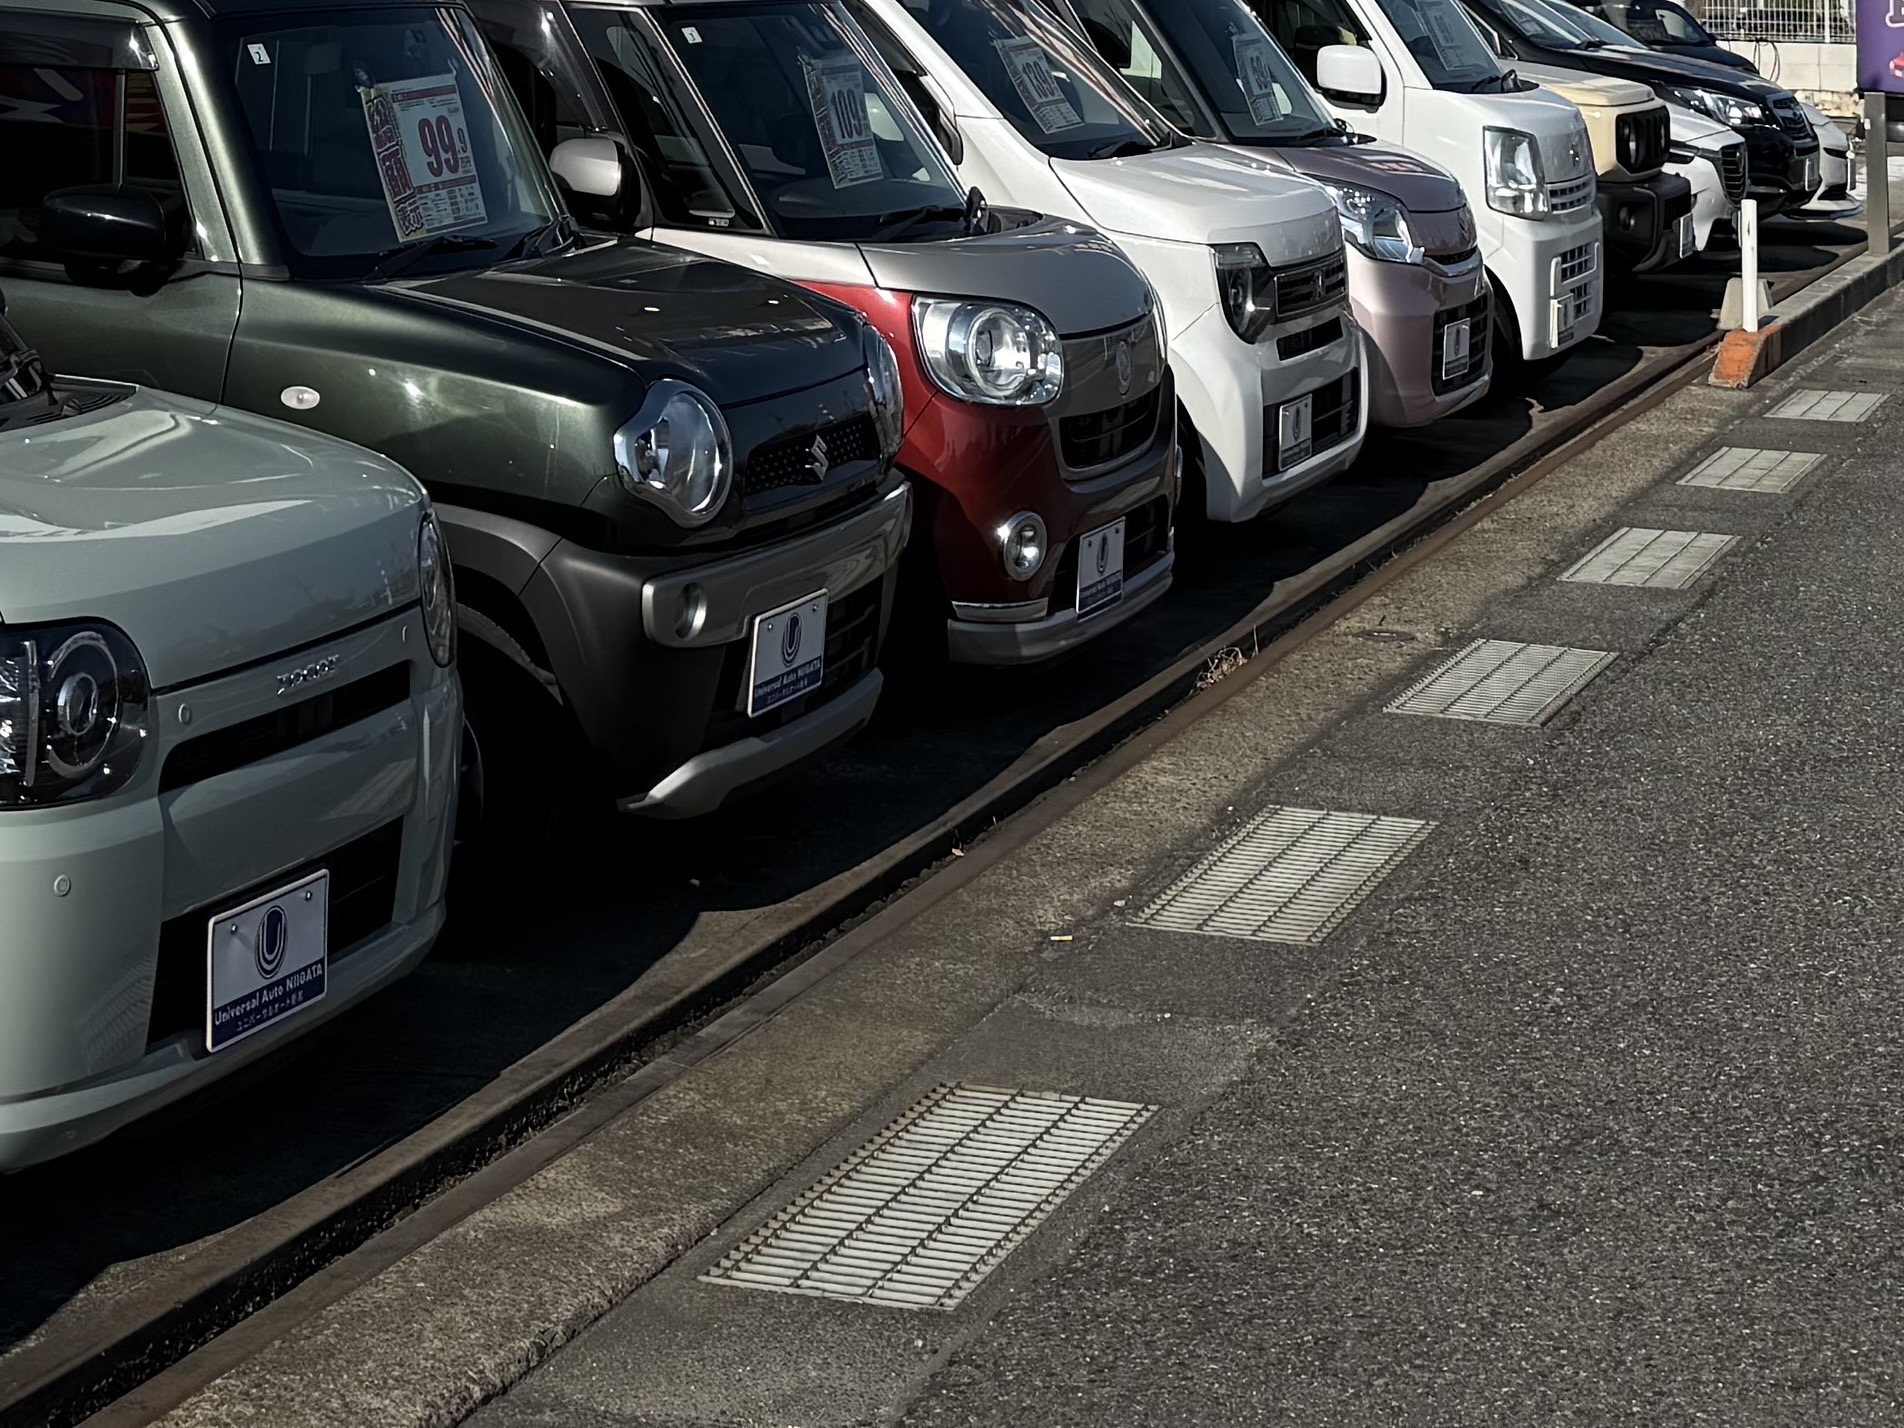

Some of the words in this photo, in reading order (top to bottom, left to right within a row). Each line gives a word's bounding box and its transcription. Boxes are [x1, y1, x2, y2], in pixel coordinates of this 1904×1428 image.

[418, 114, 468, 178] 99.9
[214, 989, 261, 1026] Universal
[261, 984, 284, 1005] Auto
